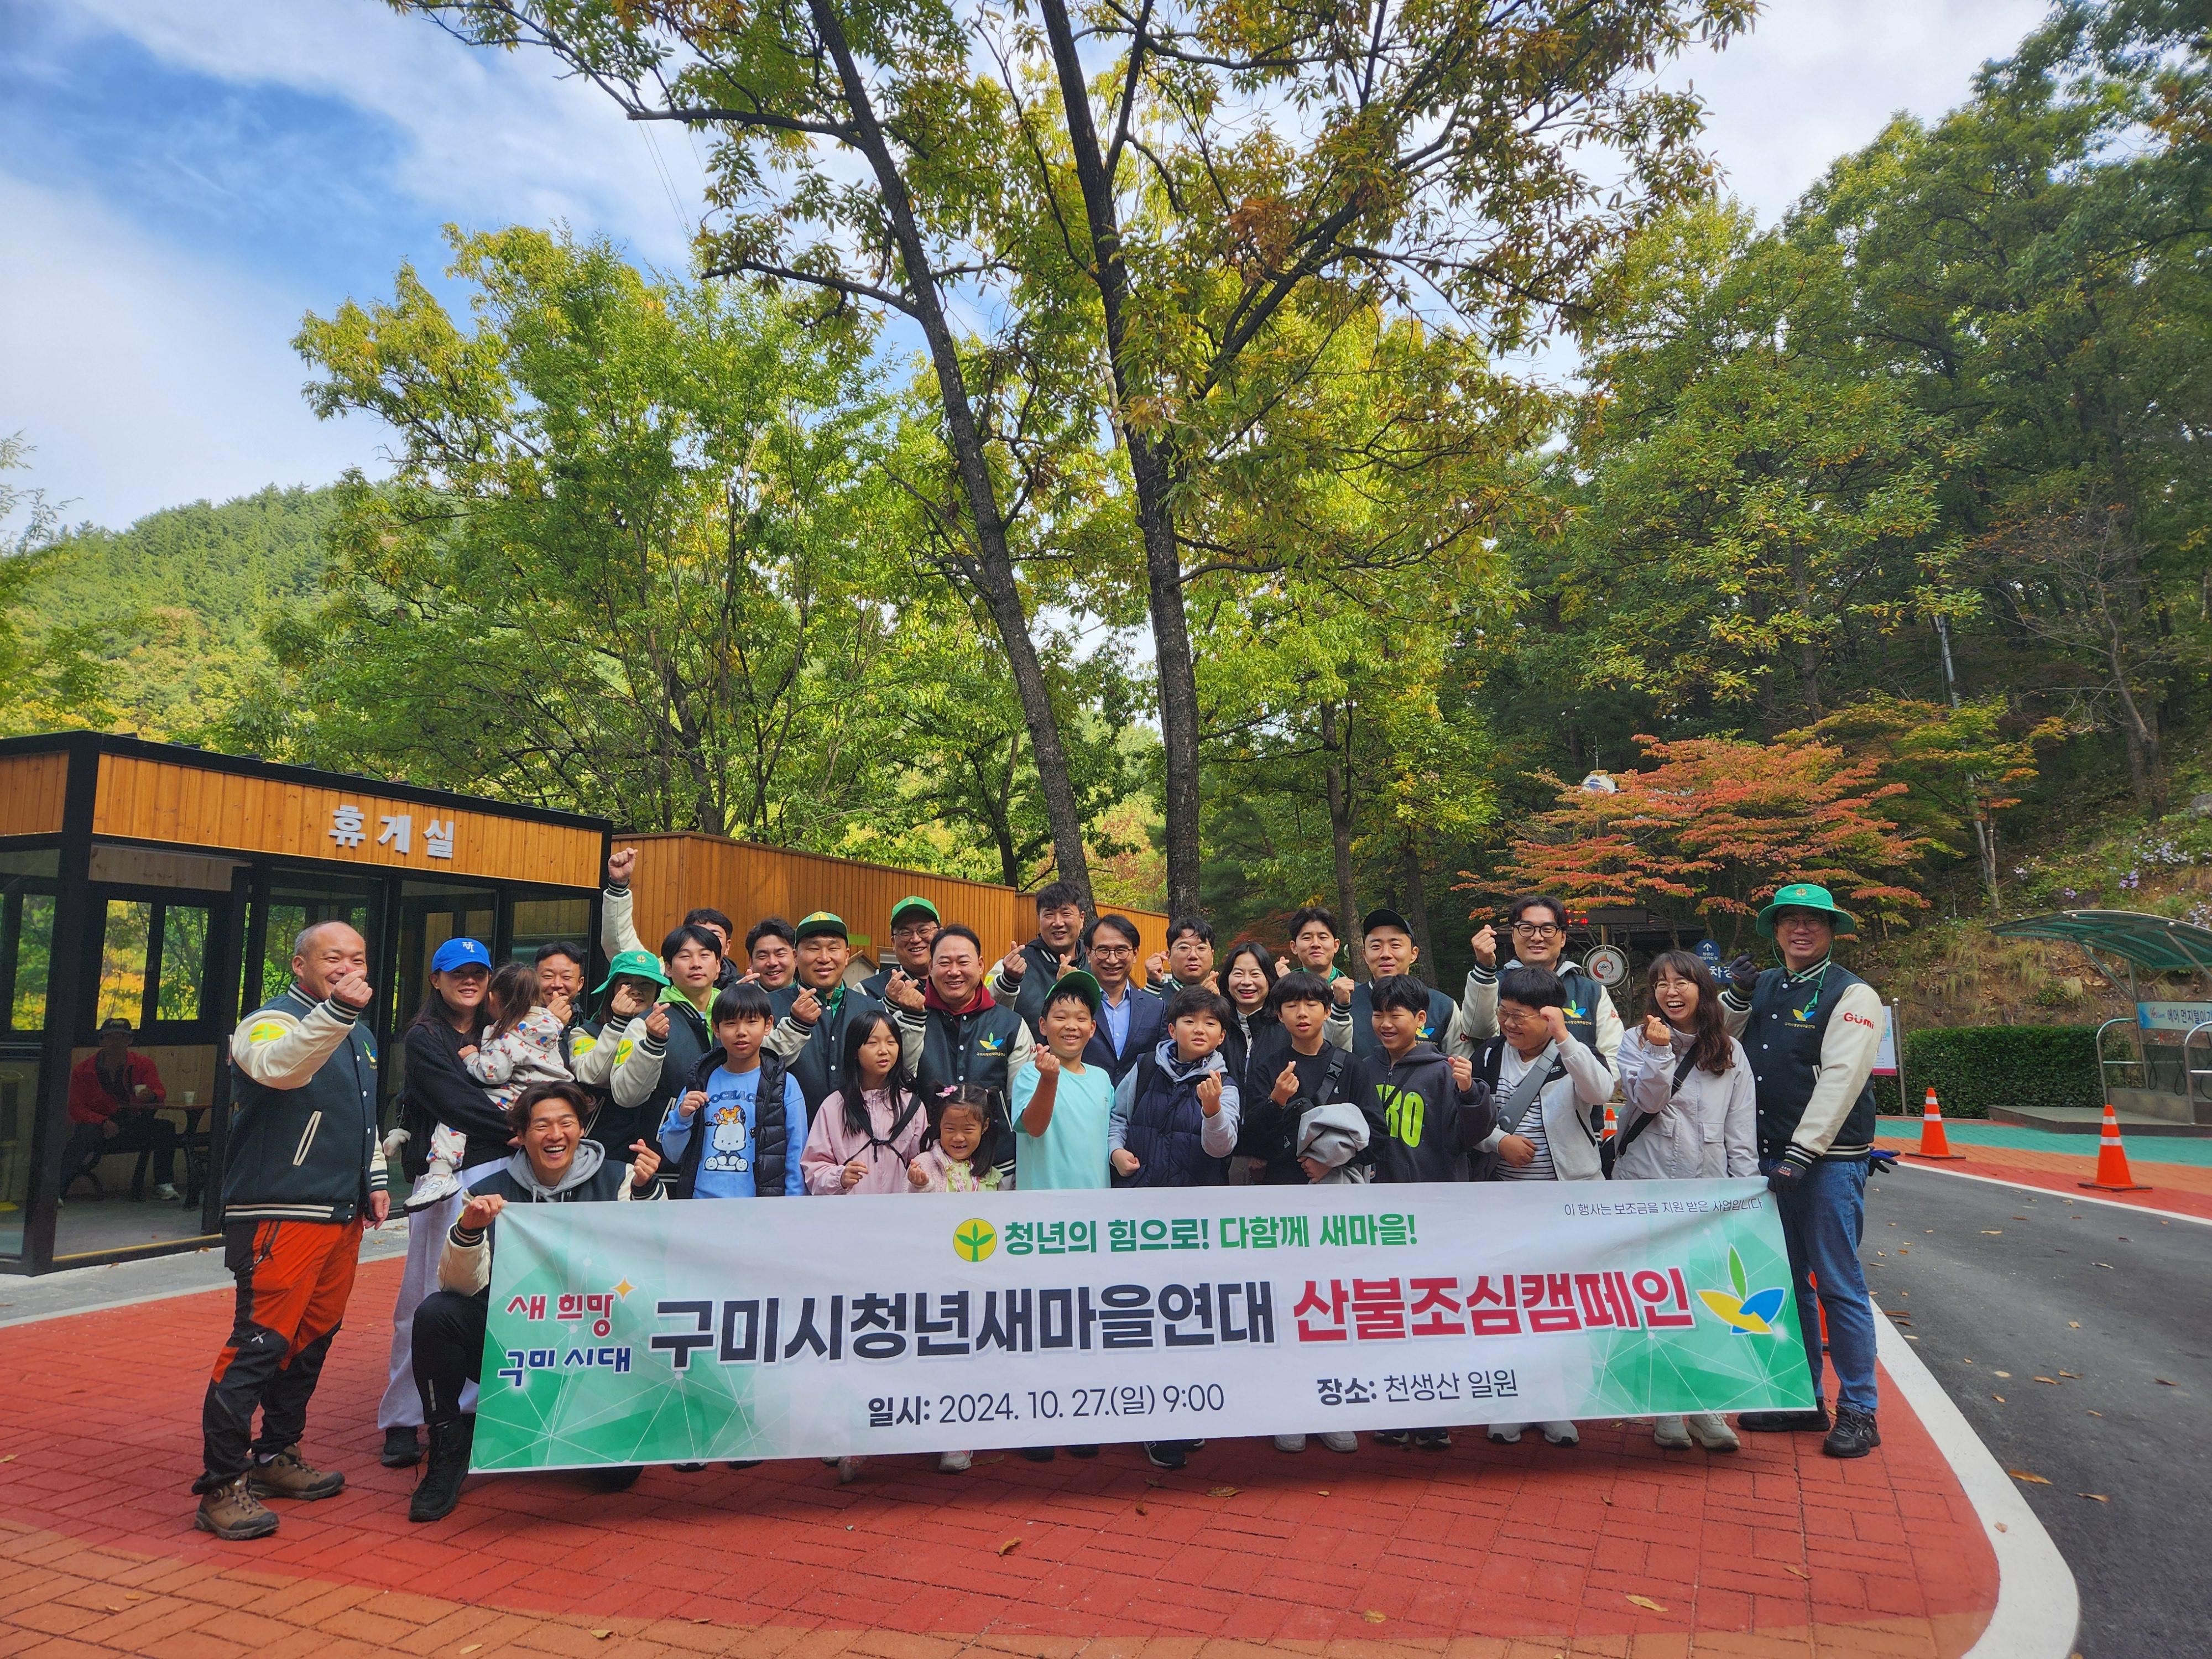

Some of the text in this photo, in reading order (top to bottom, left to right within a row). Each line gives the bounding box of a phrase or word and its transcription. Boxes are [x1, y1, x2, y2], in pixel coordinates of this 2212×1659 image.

[328, 804, 454, 858] 휴게실
[2167, 1008, 2179, 1023] 에어
[1564, 1197, 1763, 1216] 이 행사는 보조금을 지원 받은 사업입니다
[1004, 1214, 1416, 1255] 청년의 힘으로! 다함께 새마을!
[507, 1294, 614, 1337] 새 희망
[651, 1267, 1694, 1369] 구미시청년새마을연대 산불조심캠페인
[500, 1347, 630, 1386] 구미 시대
[869, 1384, 1224, 1427] 일시: 2024. 10. 27.(일) 9:00
[1317, 1370, 1518, 1405] 장소: 천생산 일원
